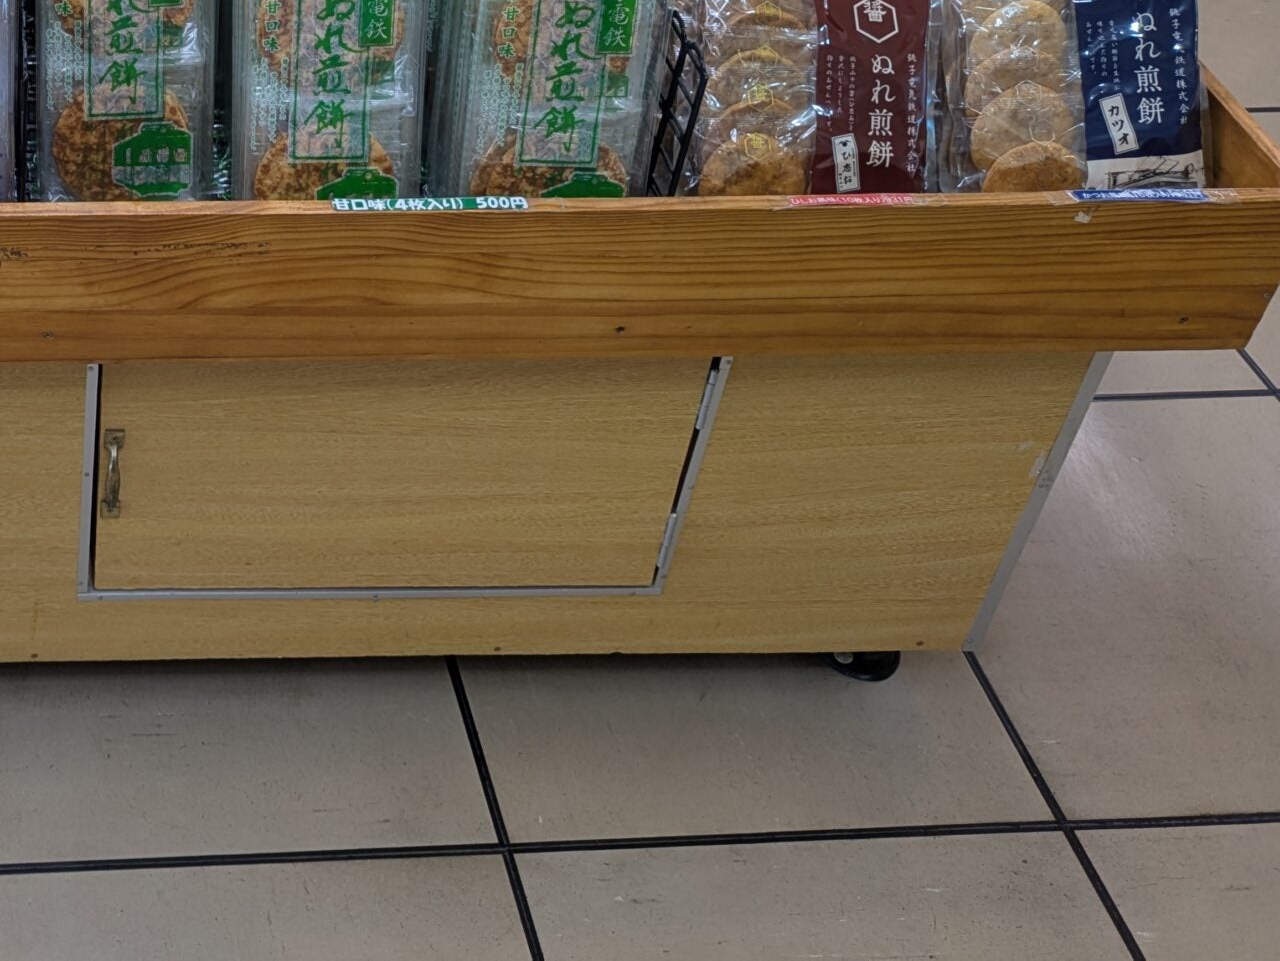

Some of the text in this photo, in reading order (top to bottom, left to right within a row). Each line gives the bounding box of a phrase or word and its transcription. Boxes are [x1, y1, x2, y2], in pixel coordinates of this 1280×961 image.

[533, 0, 603, 153] ぬれ煎餅
[865, 54, 897, 168] ぬれ煎餅
[1132, 11, 1166, 125] ぬれ煎餅
[1107, 105, 1131, 146] カツオ
[333, 196, 528, 211] 甘口味(4枚入り) 500円
